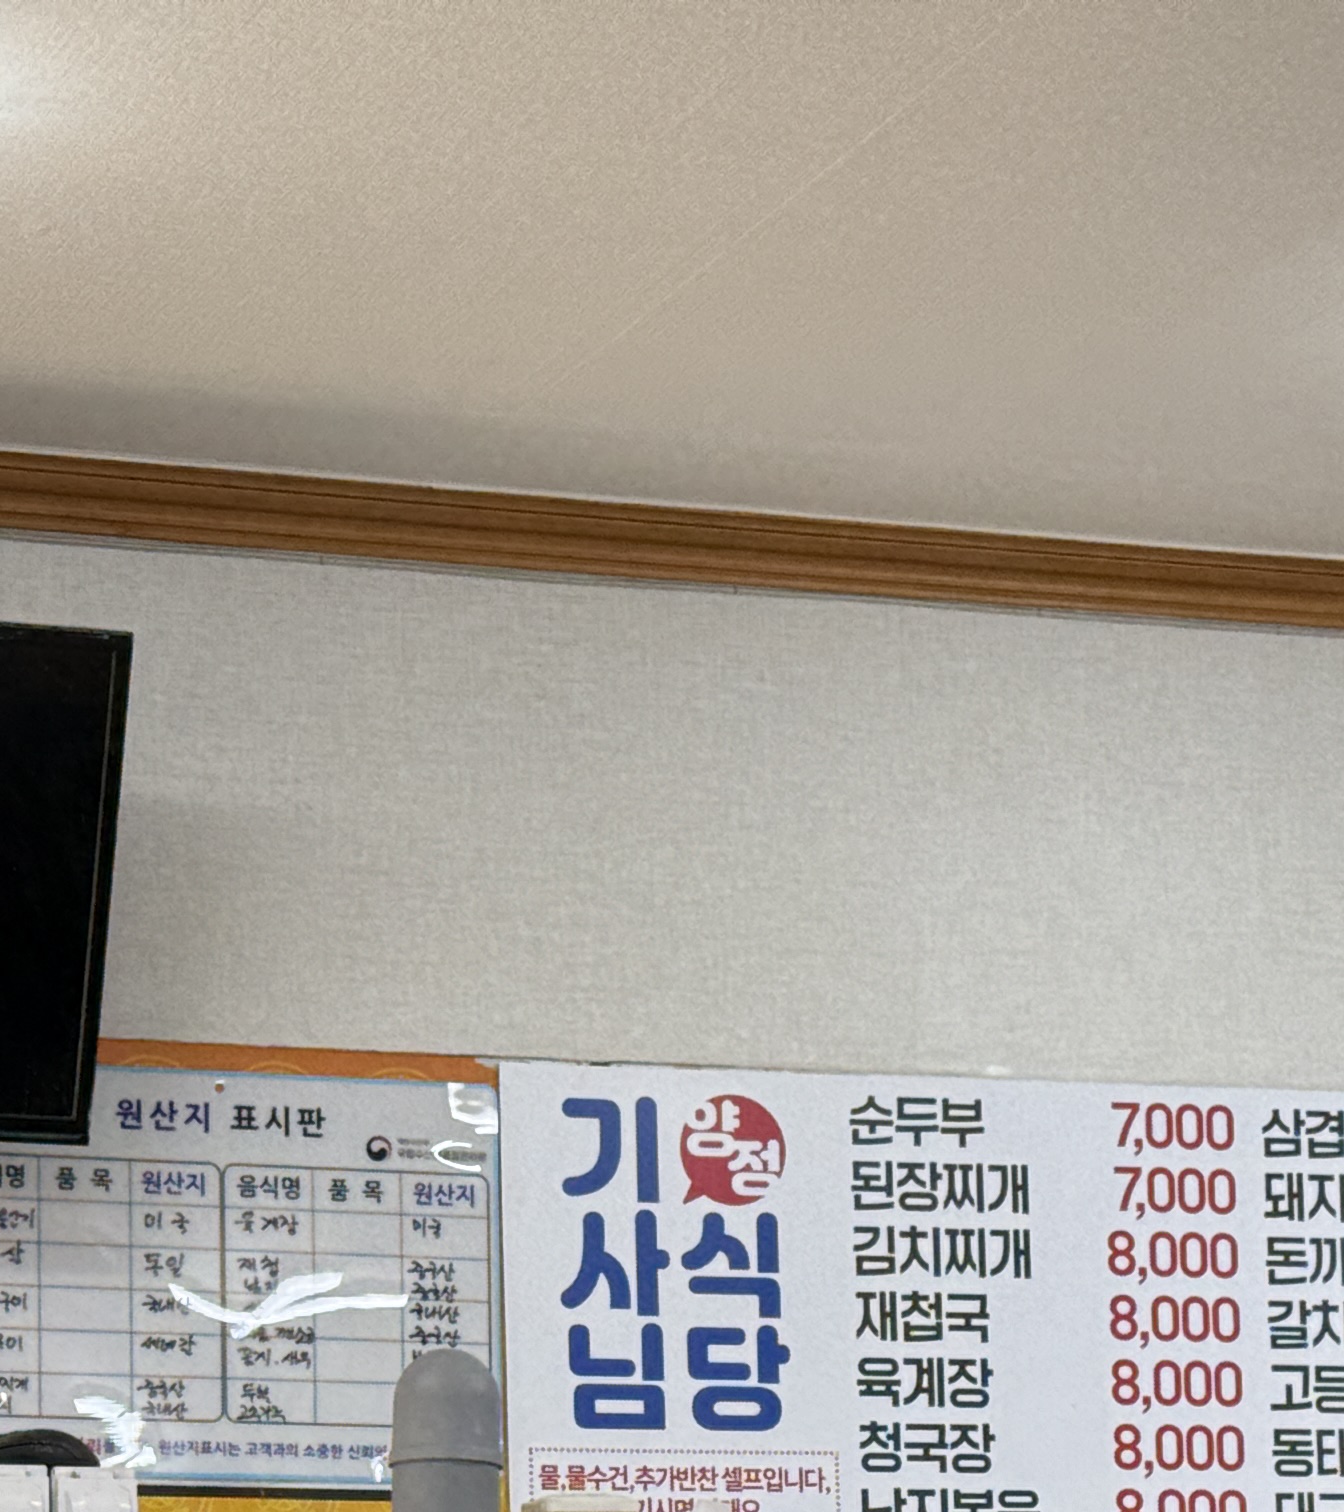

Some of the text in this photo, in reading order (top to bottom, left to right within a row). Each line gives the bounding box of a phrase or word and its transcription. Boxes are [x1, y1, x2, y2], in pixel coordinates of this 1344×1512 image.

[115, 1098, 328, 1140] 원산지 표시판
[848, 1095, 1235, 1156] 순두부 7,000
[141, 1170, 207, 1198] 원산지
[236, 1174, 301, 1201] 음식명
[412, 1183, 476, 1209] 원산지
[850, 1160, 1237, 1220] 된장찌개 7,000
[852, 1224, 1239, 1285] 김치찌개 8,000
[855, 1290, 1241, 1350] 재첩국 8,000
[856, 1357, 1243, 1414] 육계장 8,000
[158, 1440, 241, 1458] 원산지표시는
[245, 1442, 299, 1458] 고객과의
[303, 1443, 344, 1460] 소중한
[859, 1420, 1245, 1479] 청국장 8,000
[720, 1464, 833, 1495] 셀프입니다,
